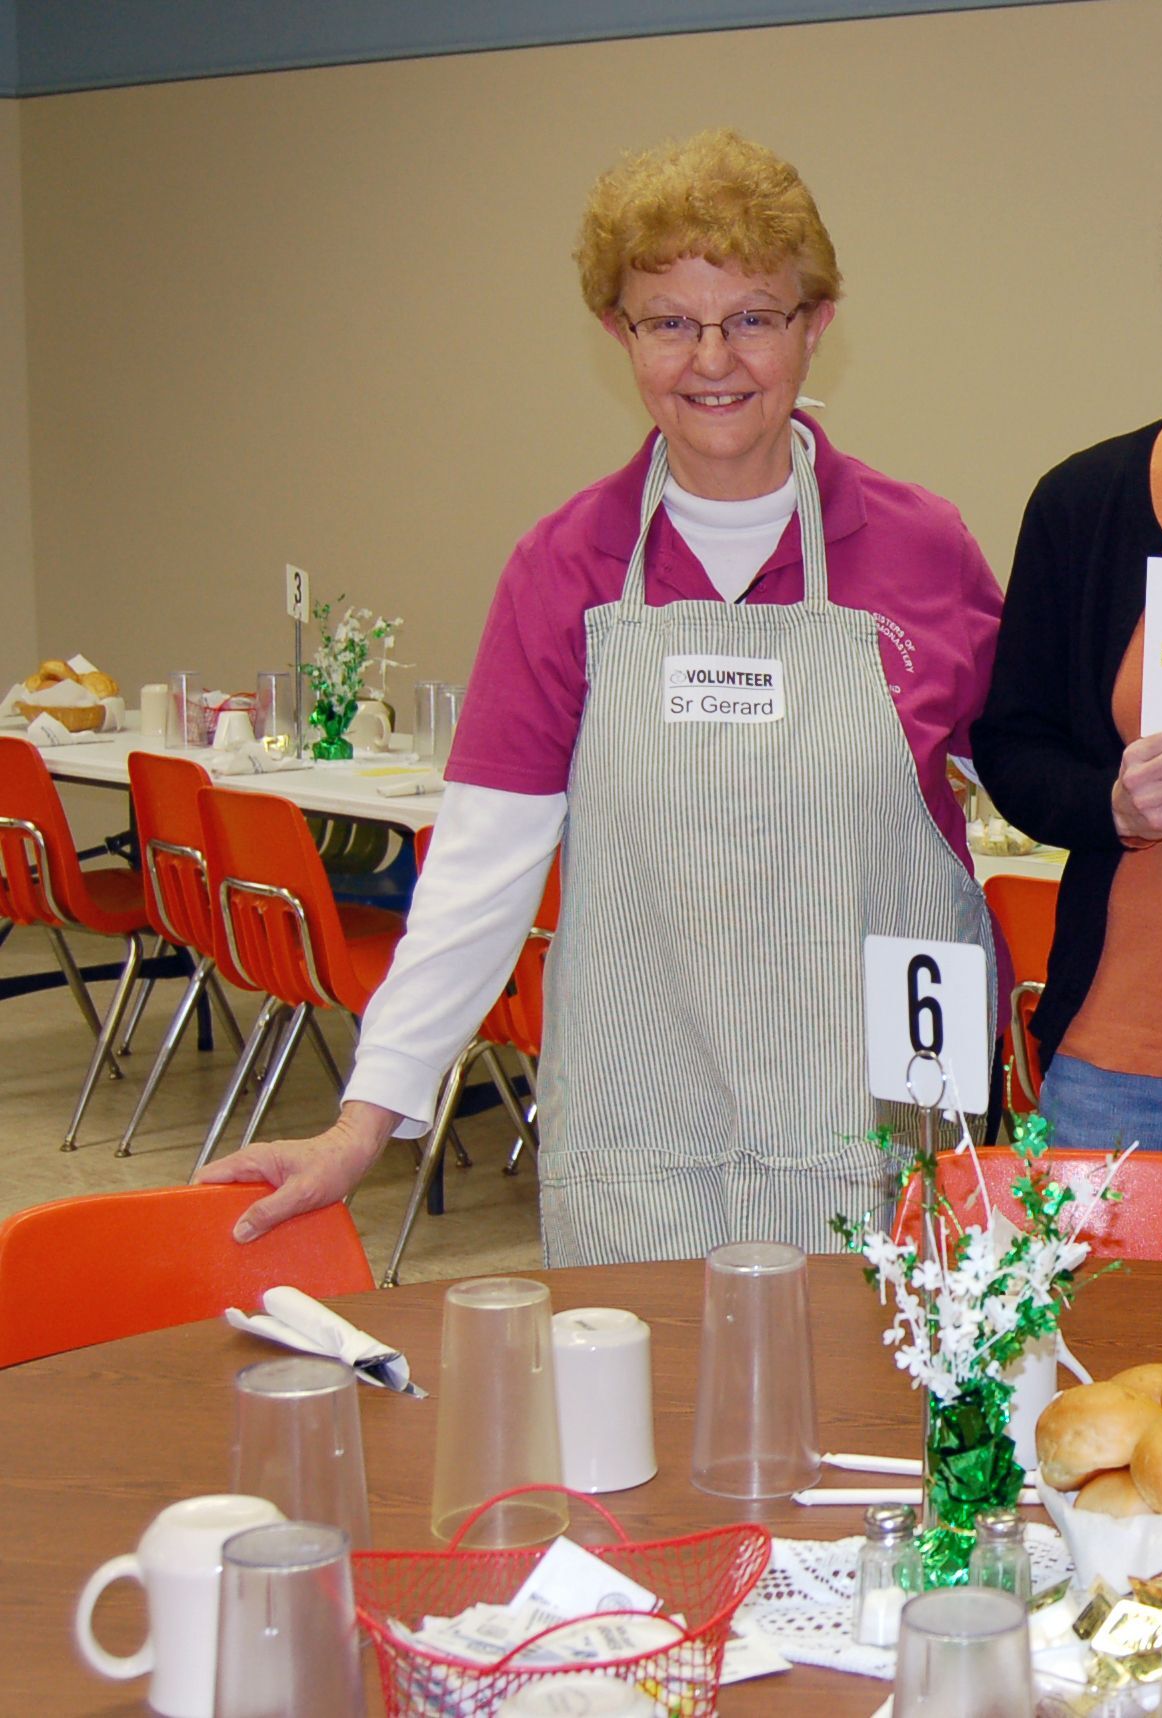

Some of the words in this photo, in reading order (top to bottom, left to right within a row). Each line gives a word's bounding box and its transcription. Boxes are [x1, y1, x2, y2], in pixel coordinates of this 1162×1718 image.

[294, 571, 302, 604] 3
[687, 670, 773, 687] VOLUNTEER
[671, 696, 693, 714] Sr
[701, 695, 773, 715] Gerard
[906, 953, 943, 1061] 6
